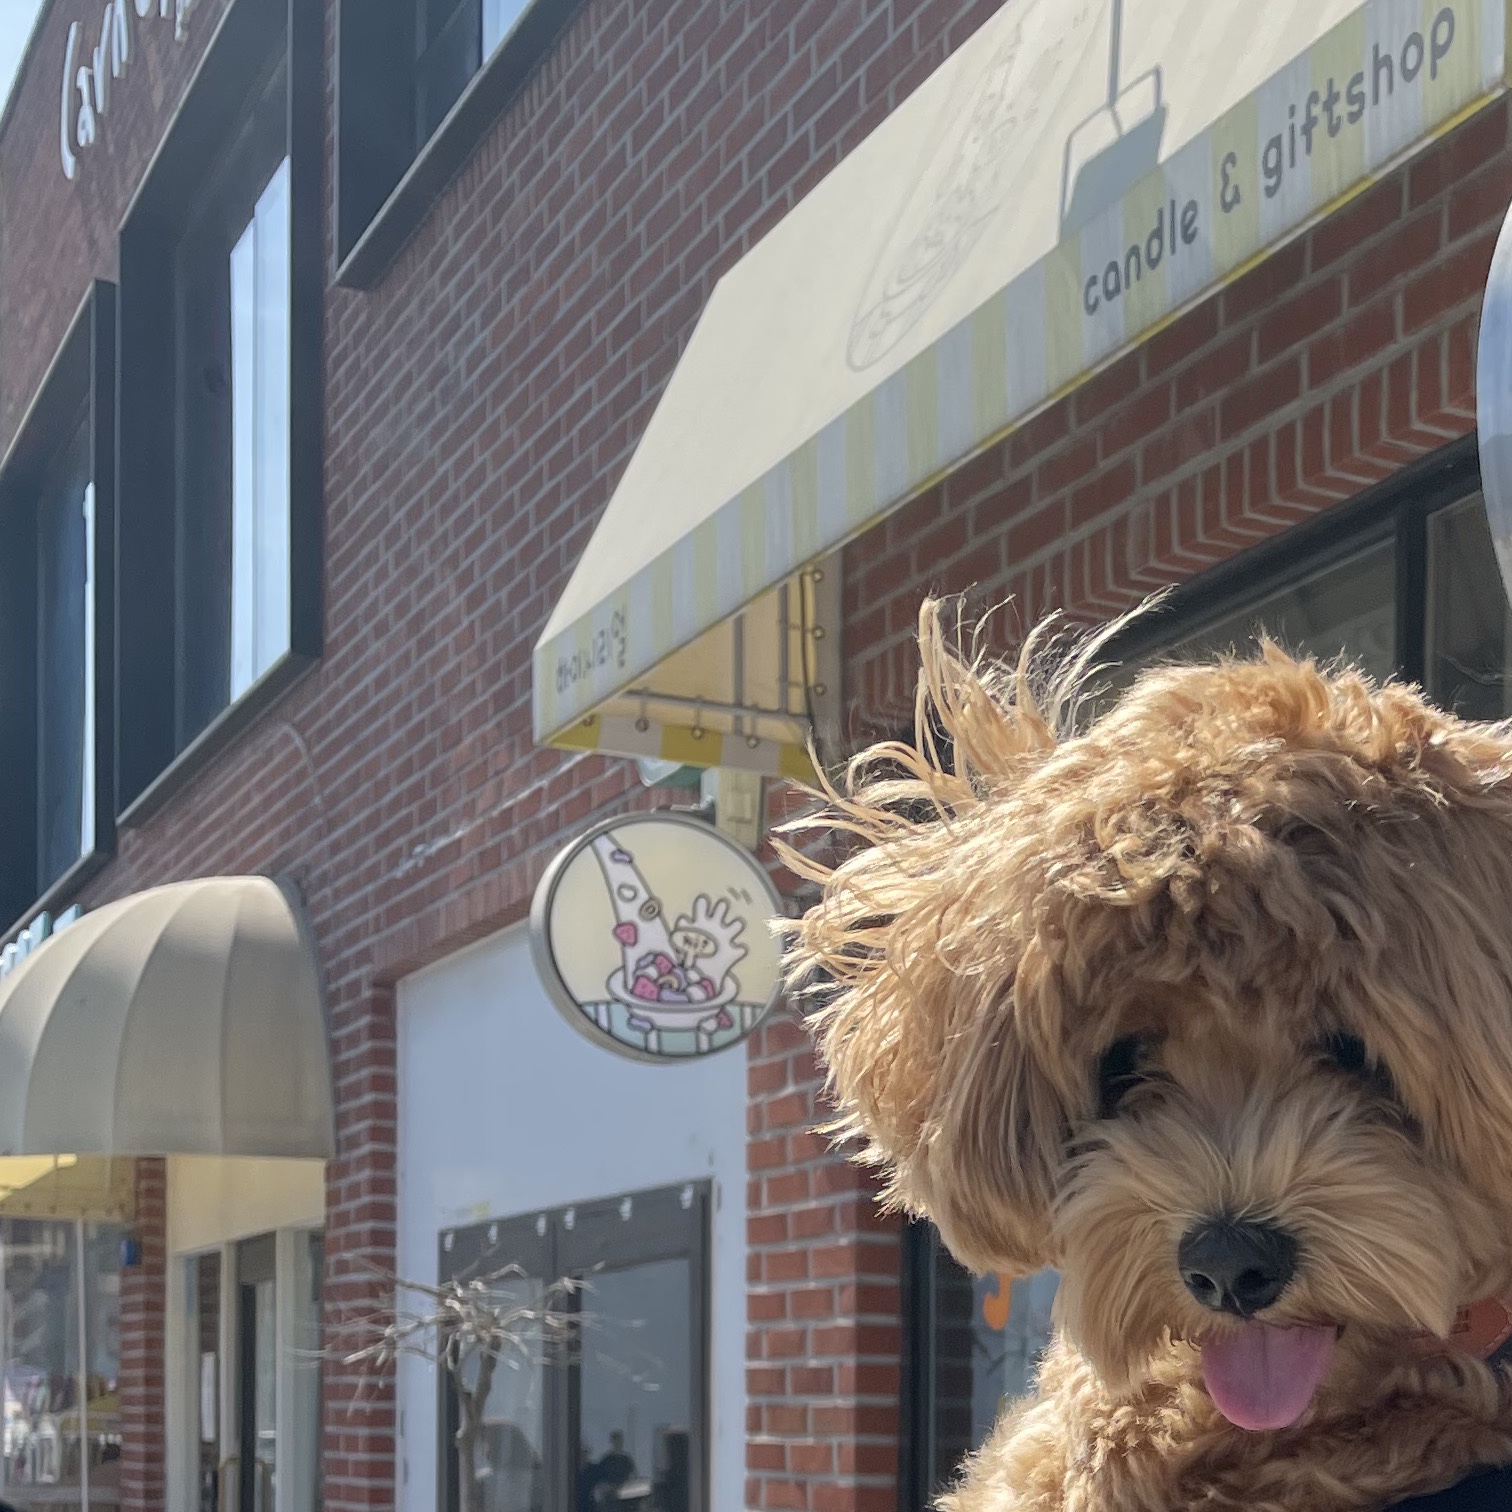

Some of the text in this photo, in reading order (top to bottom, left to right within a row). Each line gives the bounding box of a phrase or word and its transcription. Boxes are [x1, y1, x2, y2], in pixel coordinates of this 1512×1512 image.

[1083, 7, 1455, 316] candle & giftshop
